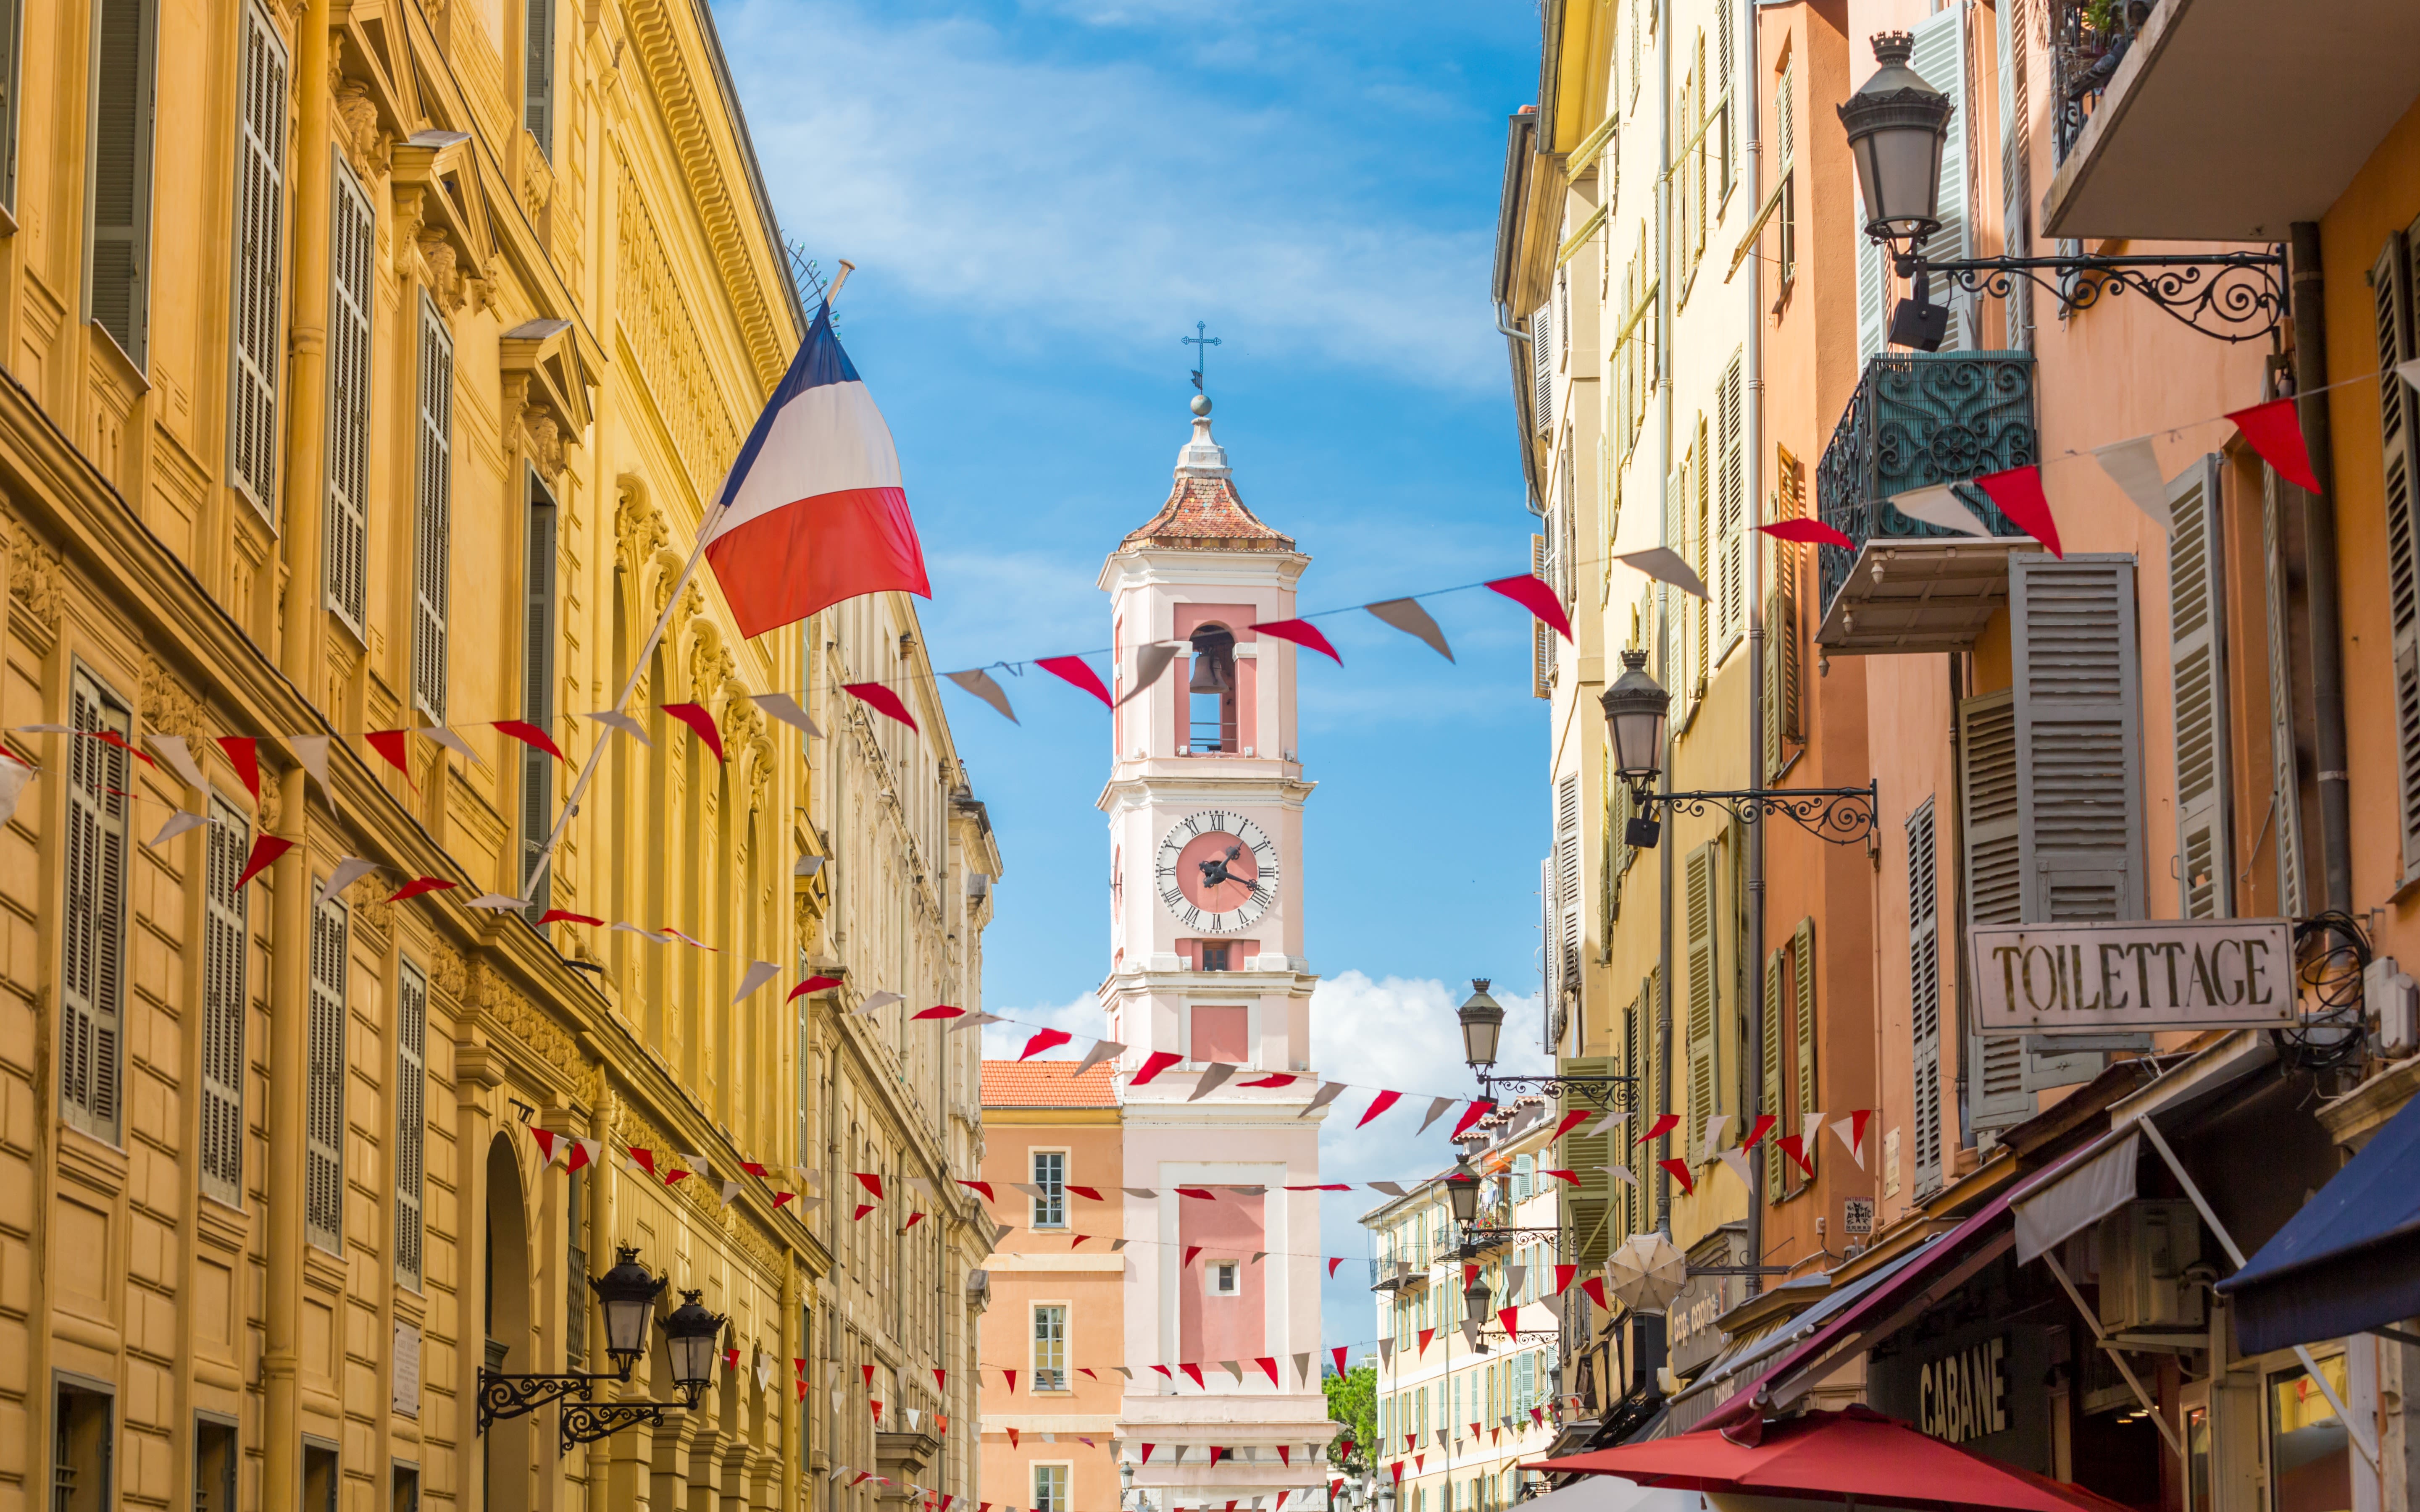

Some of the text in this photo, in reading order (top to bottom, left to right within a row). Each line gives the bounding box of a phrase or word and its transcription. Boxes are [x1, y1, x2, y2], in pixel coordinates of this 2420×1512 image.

[1184, 819, 1201, 837] XI
[1210, 814, 1225, 831] XII
[1236, 822, 1247, 837] I
[1165, 840, 1183, 855] X
[1251, 840, 1268, 855] II
[1160, 866, 1176, 877] IX
[1258, 866, 1275, 879] III
[1163, 886, 1184, 907] VIII
[1183, 904, 1200, 924] VII
[1211, 914, 1222, 930] VI
[1238, 908, 1249, 924] V
[1992, 939, 2273, 1012] TOILETTAGE
[1920, 1336, 2006, 1443] CABANE
